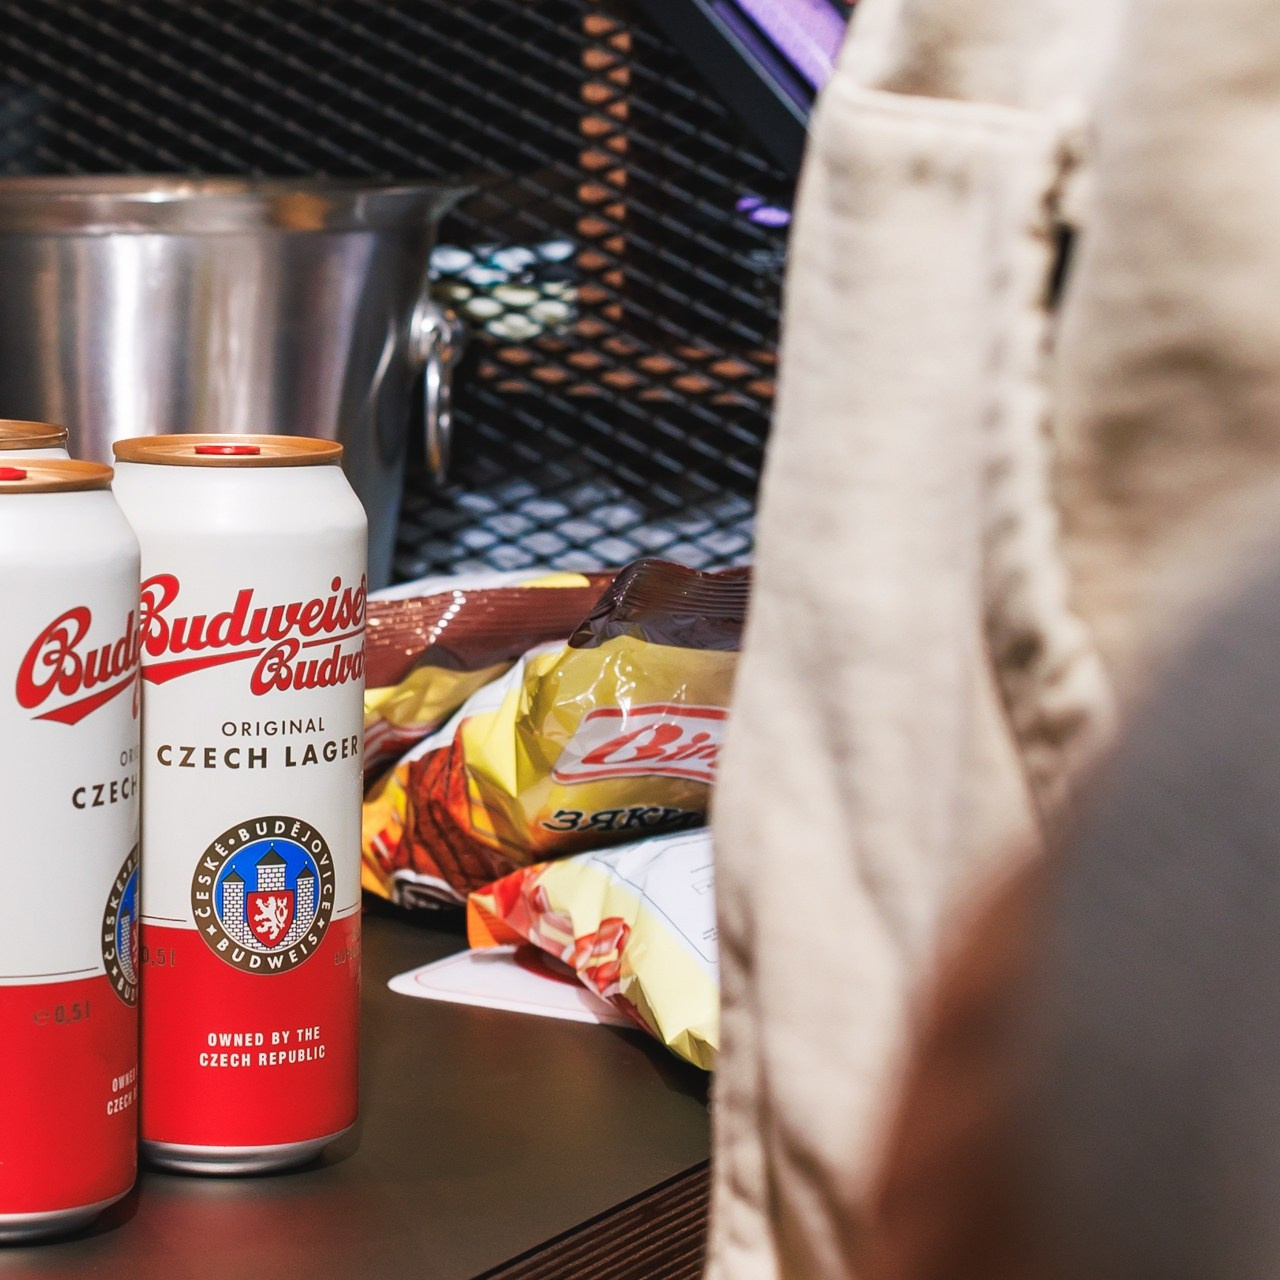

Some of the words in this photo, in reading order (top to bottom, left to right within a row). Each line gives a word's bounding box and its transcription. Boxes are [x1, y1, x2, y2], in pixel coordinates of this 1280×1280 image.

[221, 717, 325, 736] ORIGINAL
[157, 745, 267, 769] CZECH
[285, 735, 358, 767] LAGER
[238, 820, 332, 910] BUDĚJOVICE
[216, 934, 319, 970] BUDWEIS
[207, 1031, 265, 1047] OWNED
[271, 1029, 291, 1046] BY
[296, 1025, 320, 1042] THE
[199, 1052, 251, 1068] CZECH
[258, 1045, 326, 1067] REPUBLIC
